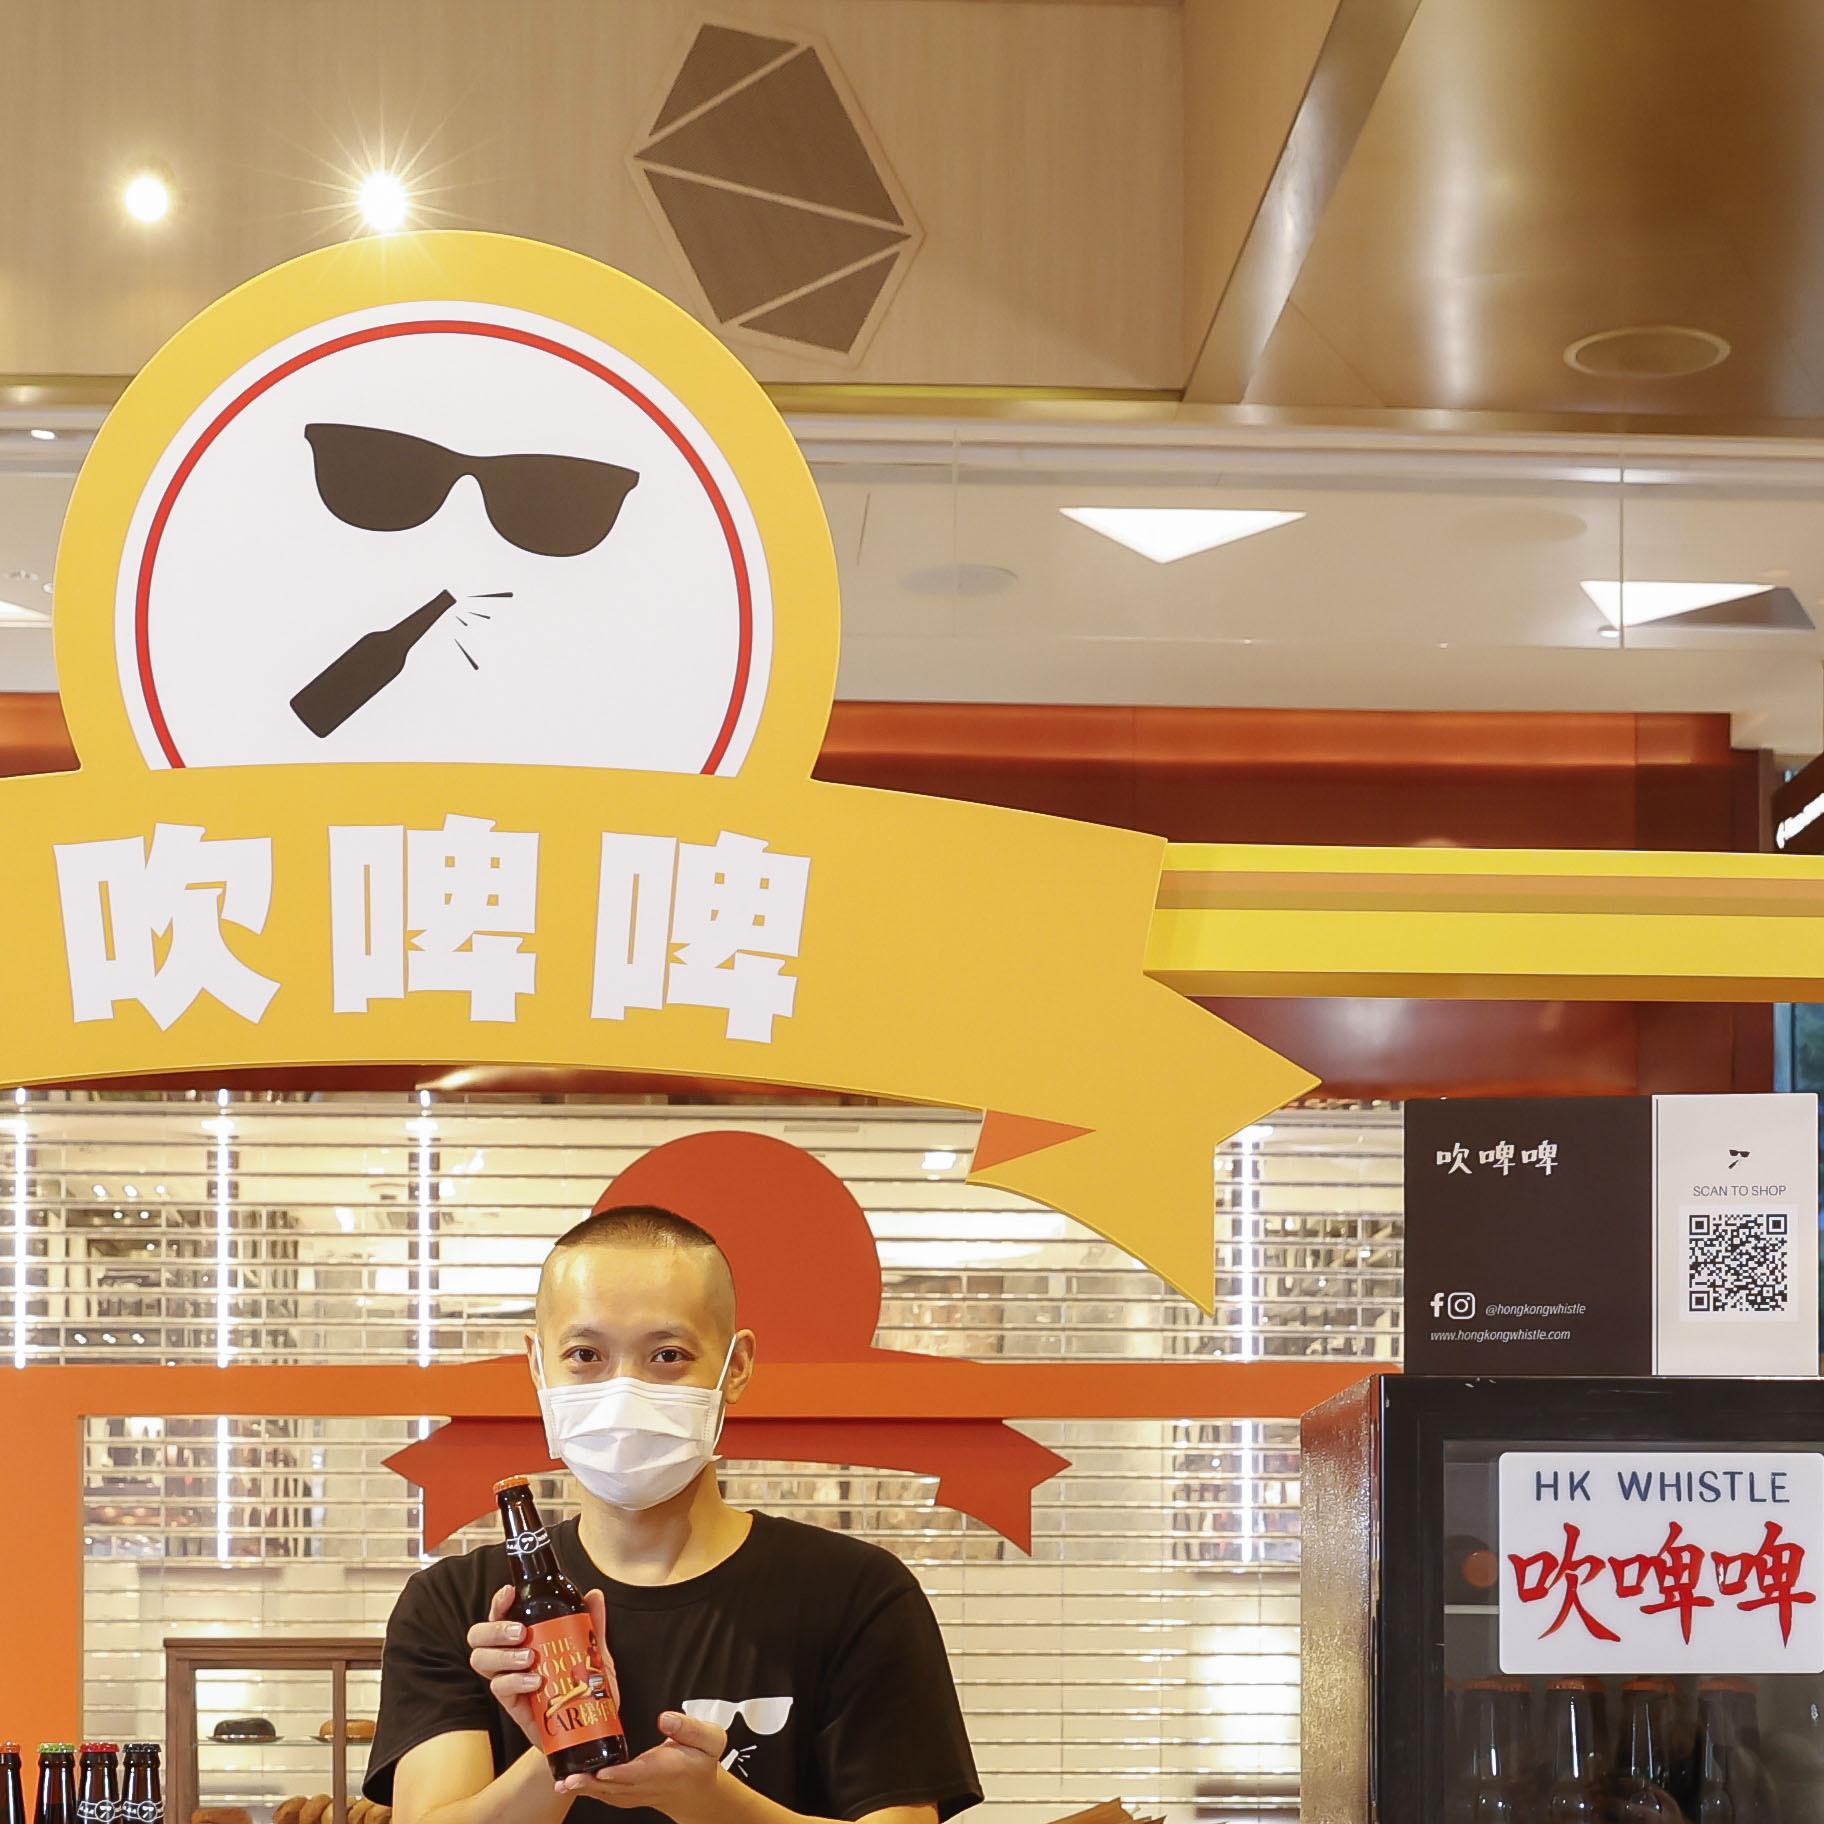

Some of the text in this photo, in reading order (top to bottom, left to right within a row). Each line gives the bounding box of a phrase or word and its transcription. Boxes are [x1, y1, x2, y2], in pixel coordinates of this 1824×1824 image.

[53, 812, 811, 1044] 吹啤啤
[1436, 1140, 1558, 1176] 吹啤啤
[1693, 1185, 1787, 1197] SCAN TO SHOP
[1485, 1303, 1586, 1317] @hongkongwhistle
[1430, 1329, 1571, 1343] www.hongkongwhistle.com
[1535, 1470, 1790, 1503] HK WHISTLE
[1508, 1520, 1816, 1649] 吹啤啤
